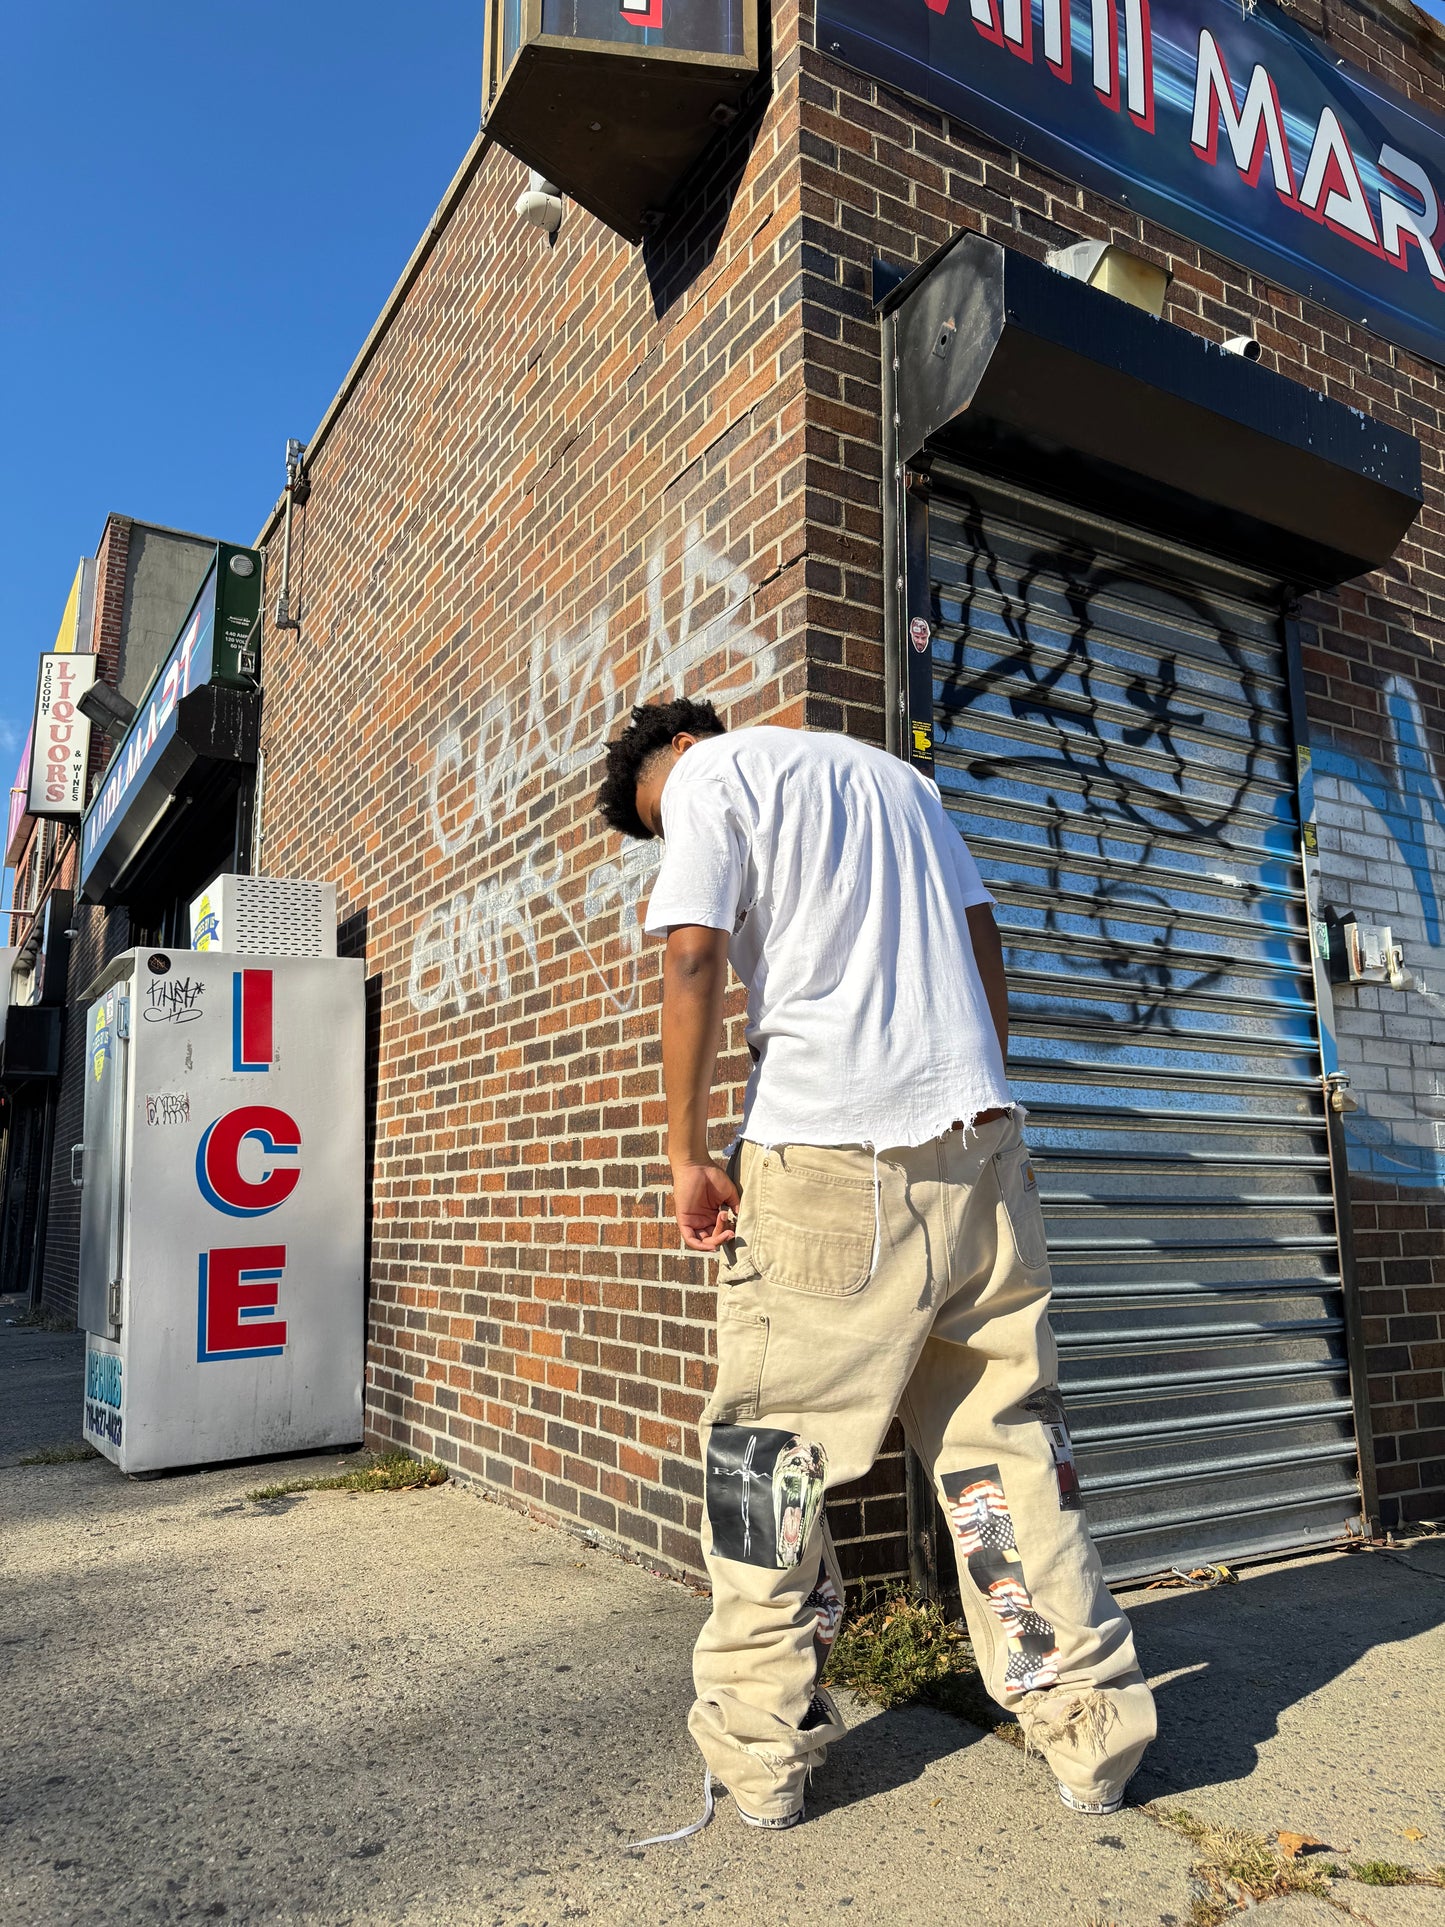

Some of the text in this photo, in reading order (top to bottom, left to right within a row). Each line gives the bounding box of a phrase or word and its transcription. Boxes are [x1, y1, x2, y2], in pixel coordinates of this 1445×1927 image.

[41, 662, 54, 715] DISCOUNT
[45, 661, 77, 803] LIQUORS
[72, 750, 83, 802] & WINES
[197, 968, 303, 1363] ICE
